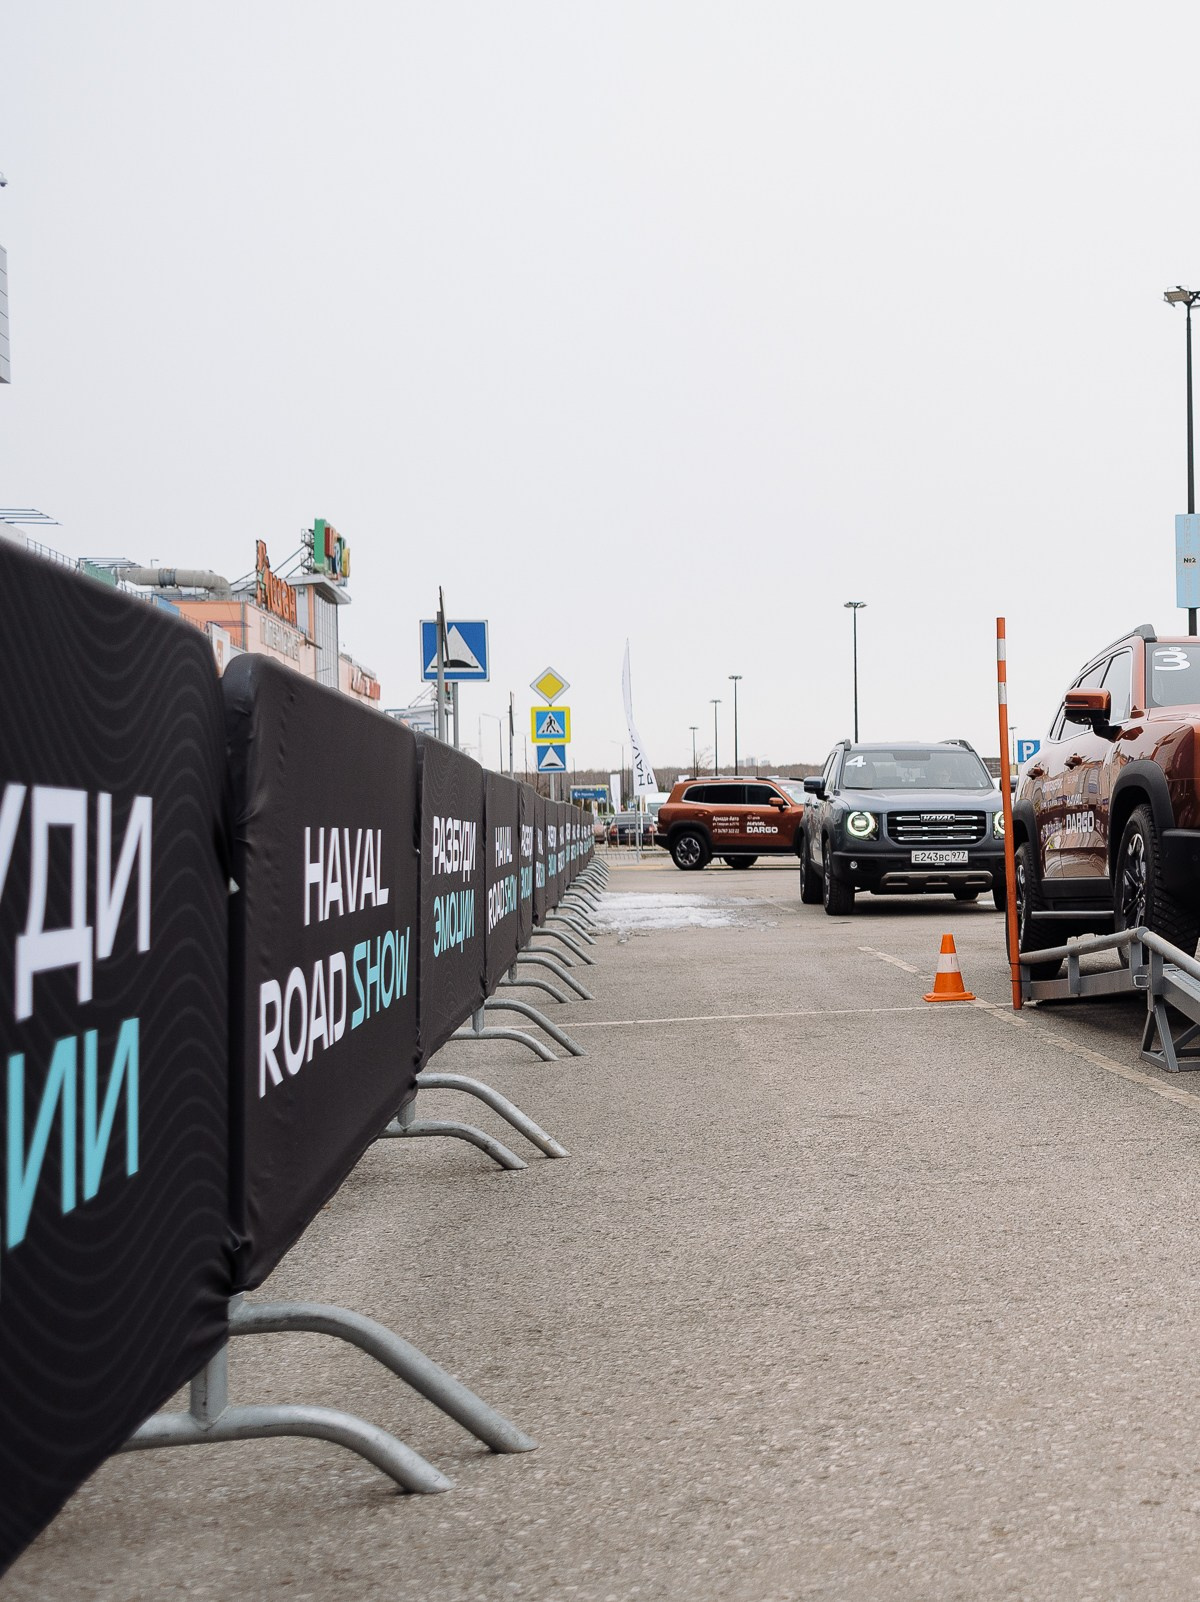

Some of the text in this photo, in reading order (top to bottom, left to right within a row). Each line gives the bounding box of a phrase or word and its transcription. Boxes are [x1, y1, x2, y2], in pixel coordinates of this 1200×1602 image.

[1154, 650, 1191, 671] 3
[845, 755, 867, 767] 4
[746, 826, 779, 834] DARGO
[1065, 810, 1095, 835] DARGO
[432, 815, 476, 883] РАЗБУДИ
[914, 851, 966, 862] Е243ВС 977
[304, 826, 389, 926] HAVAL
[433, 888, 475, 958] ЭМОЦИИ
[488, 879, 505, 935] ROAD
[259, 926, 410, 1100] ROAD SHOW
